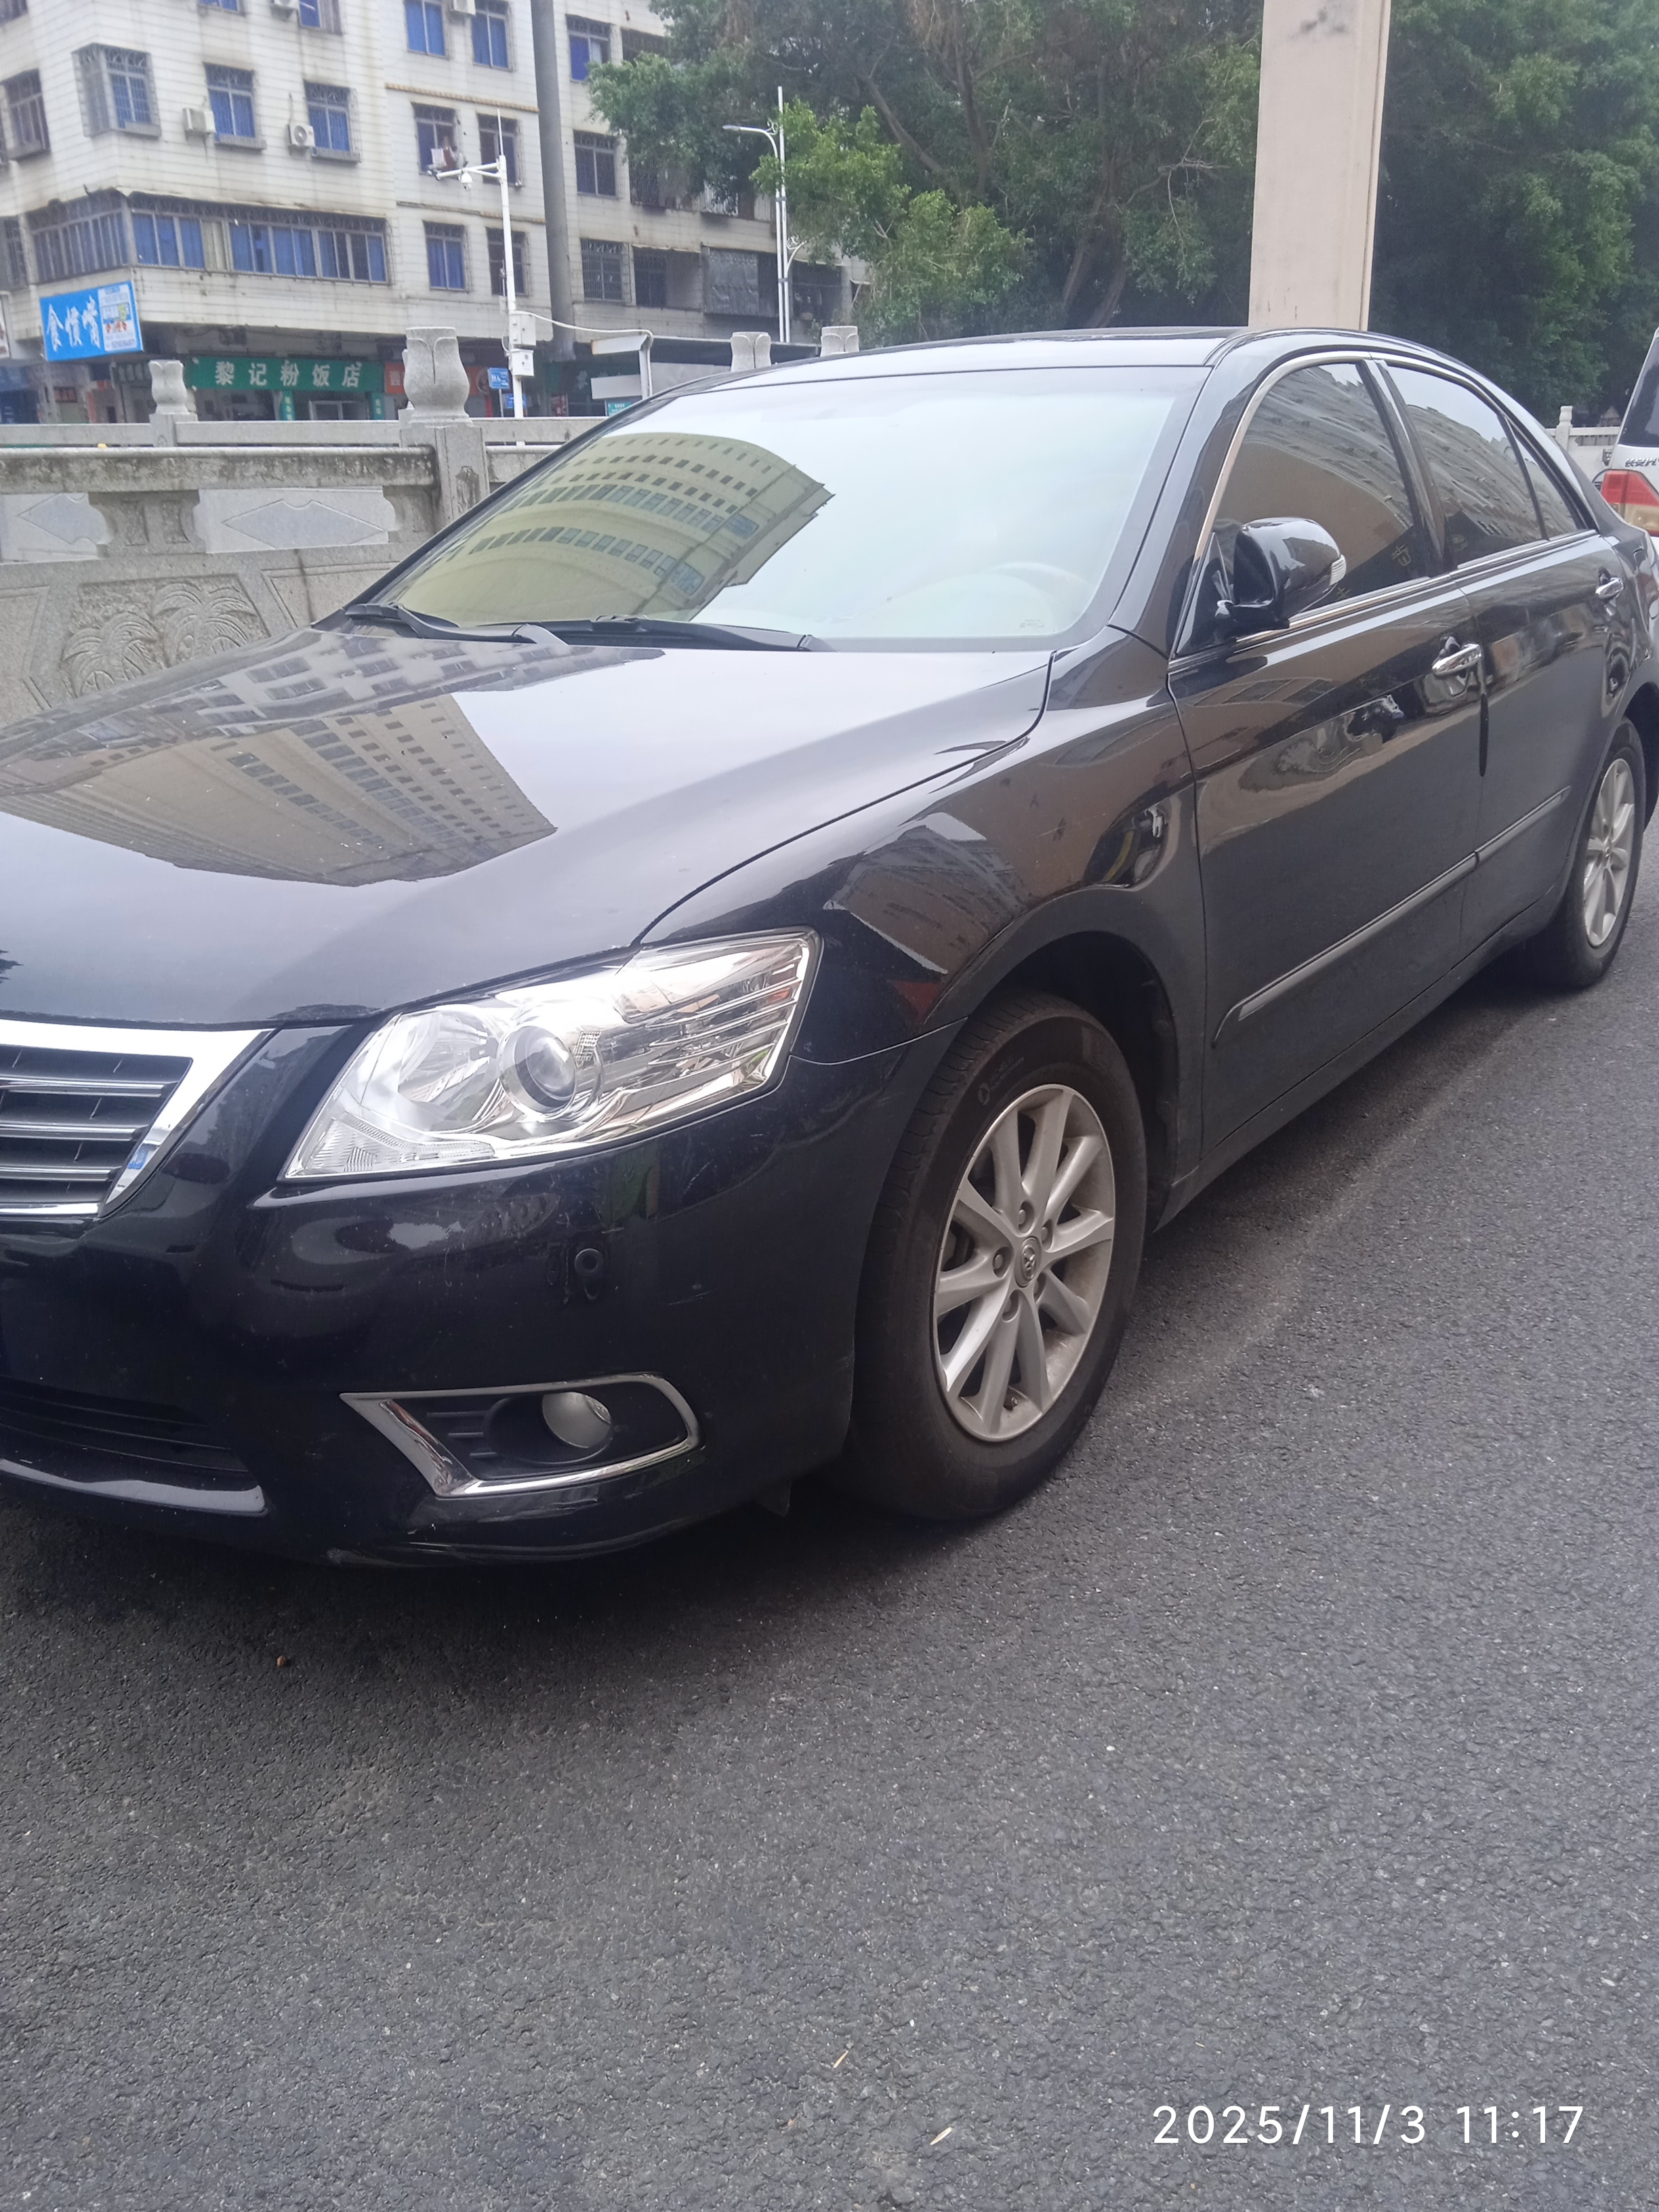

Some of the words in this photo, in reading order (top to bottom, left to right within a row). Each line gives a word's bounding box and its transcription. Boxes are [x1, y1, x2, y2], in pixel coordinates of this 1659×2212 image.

[215, 360, 362, 388] 黎记粉饭店
